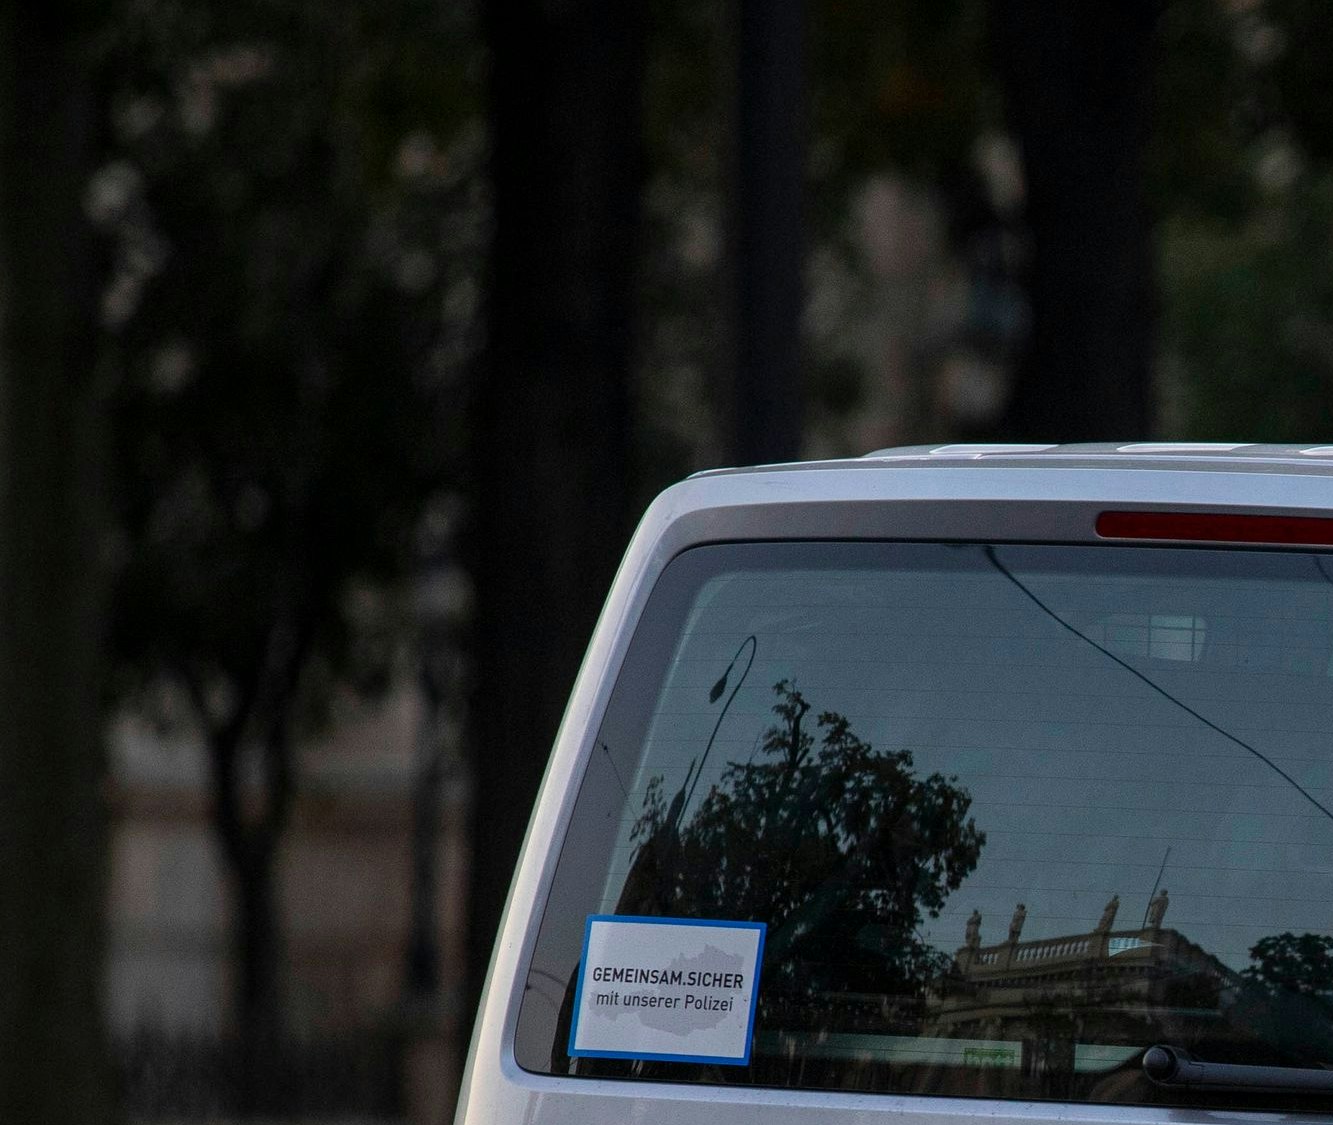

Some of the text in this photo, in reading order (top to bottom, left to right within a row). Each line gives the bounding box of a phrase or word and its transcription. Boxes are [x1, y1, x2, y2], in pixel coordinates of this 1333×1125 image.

[592, 967, 744, 989] GEMEINSAM.SICHER
[596, 991, 734, 1012] mit unserer Polizei
